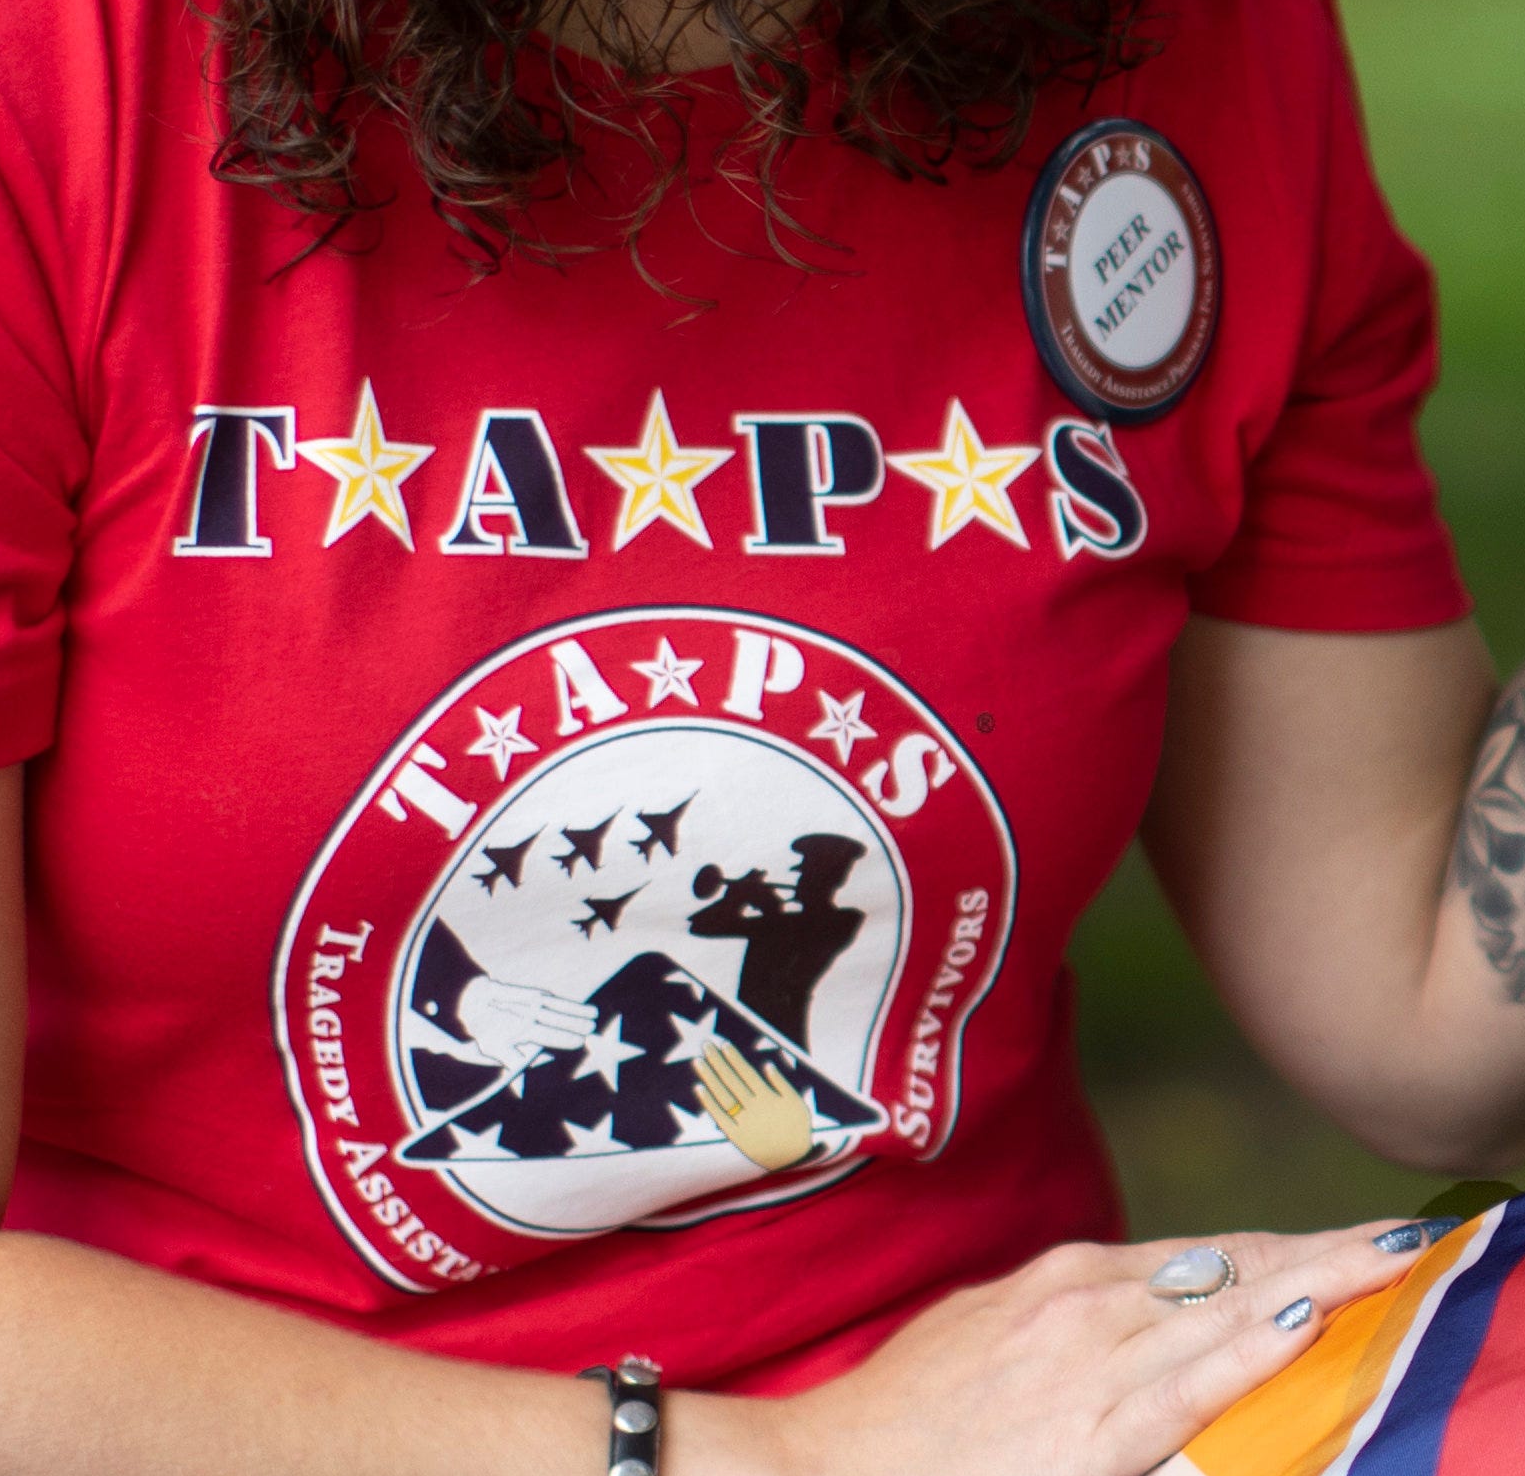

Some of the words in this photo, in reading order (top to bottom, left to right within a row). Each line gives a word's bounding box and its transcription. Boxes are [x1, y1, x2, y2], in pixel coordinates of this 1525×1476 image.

[1092, 213, 1152, 285] PEER
[1092, 229, 1185, 343] MENTOR
[306, 918, 375, 1129] TRAGEDY
[892, 885, 990, 1148] SURVIVORS
